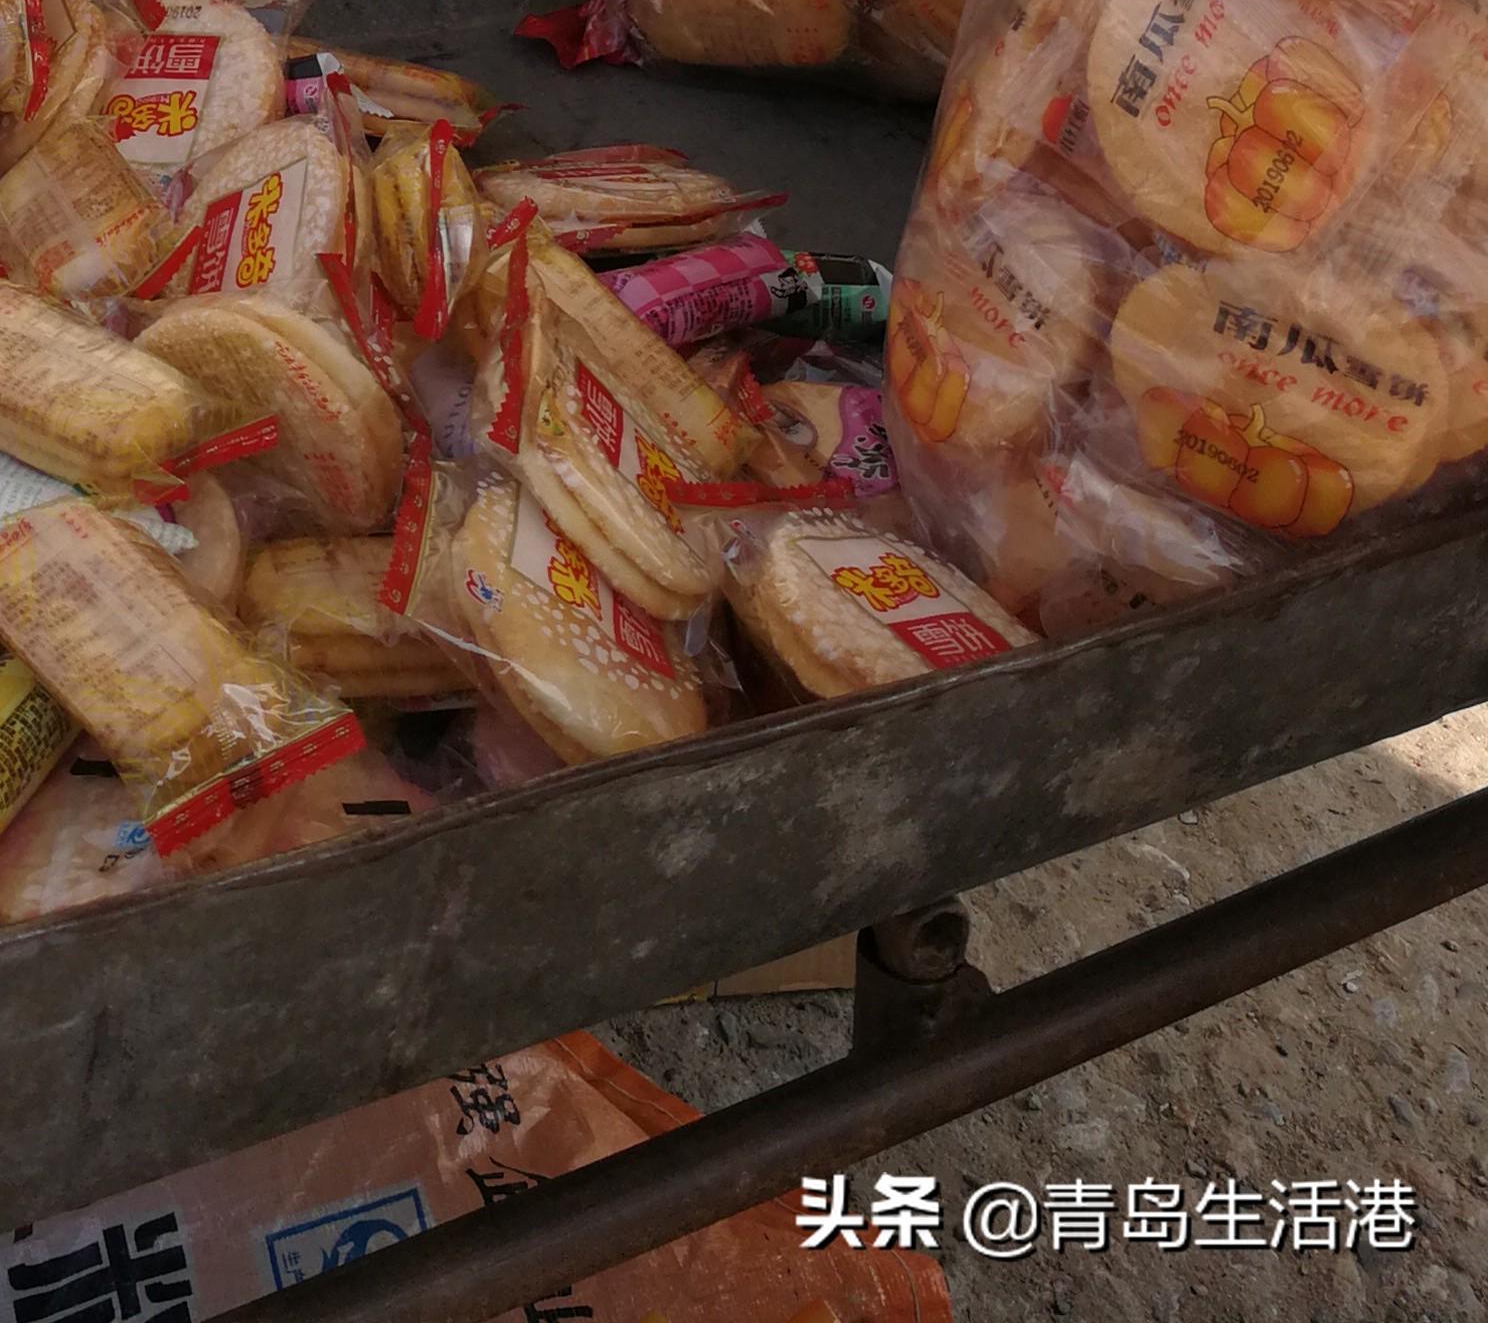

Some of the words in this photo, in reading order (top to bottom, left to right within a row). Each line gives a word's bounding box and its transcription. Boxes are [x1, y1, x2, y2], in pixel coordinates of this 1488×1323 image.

[1154, 54, 1198, 128] once
[1310, 385, 1409, 432] more
[906, 617, 997, 656] 雪饼
